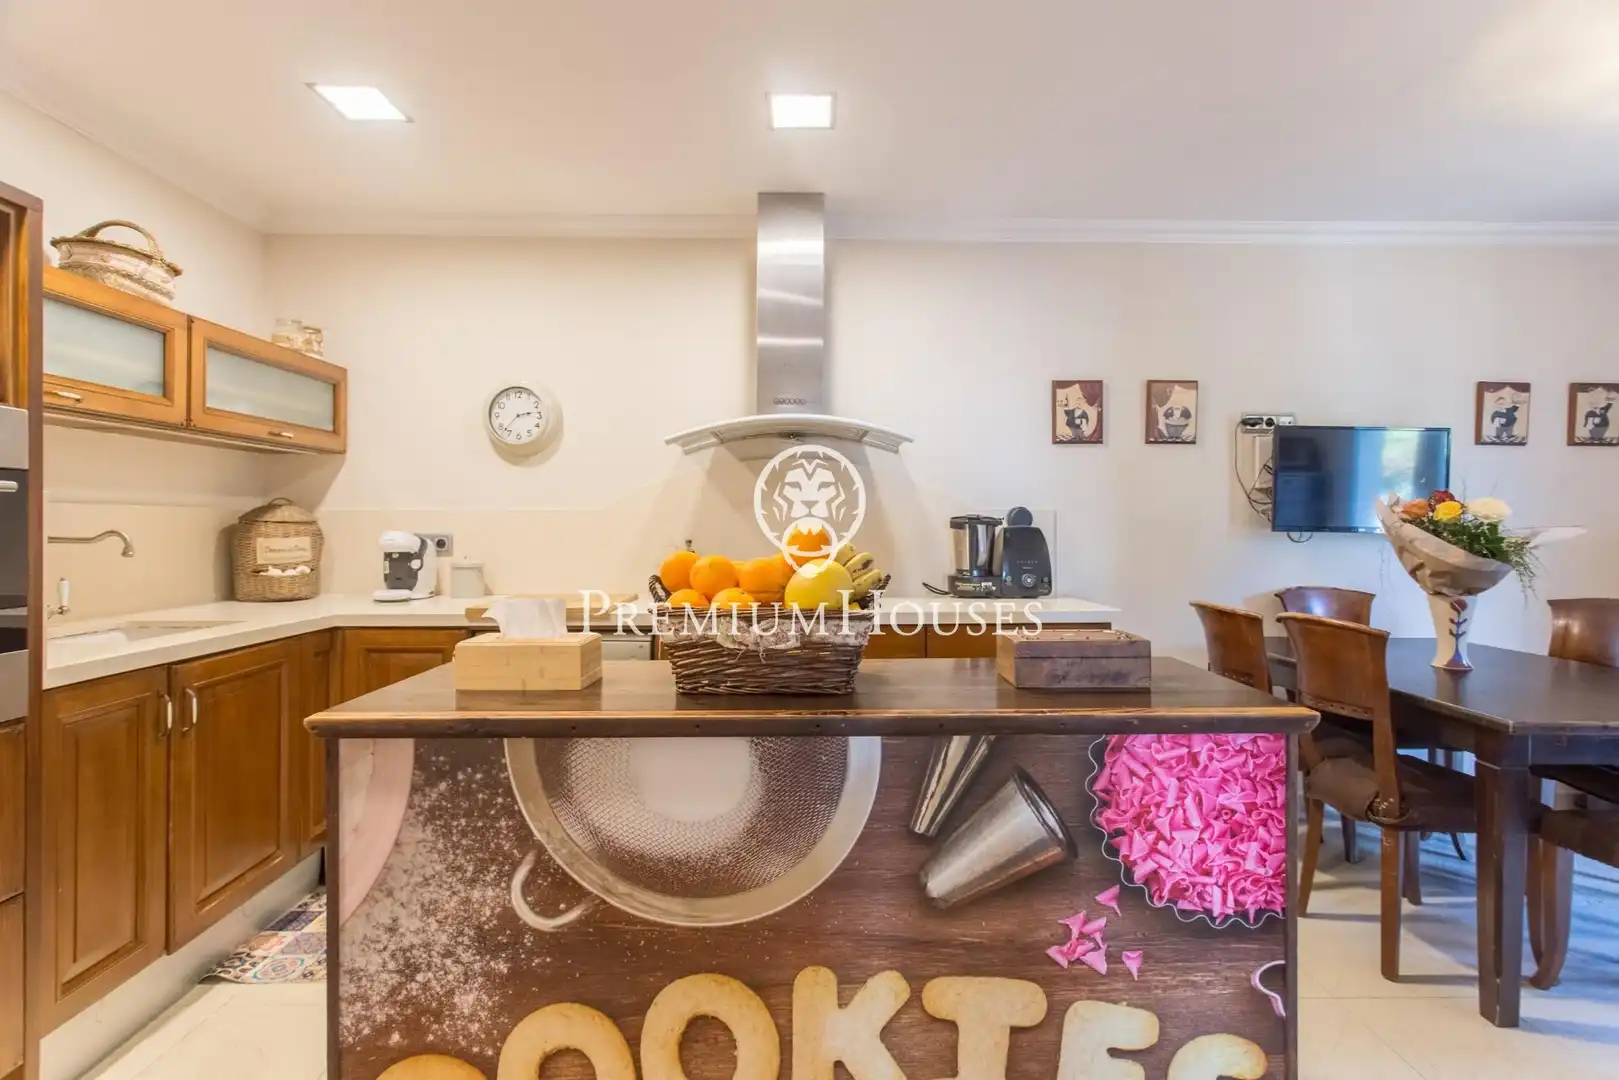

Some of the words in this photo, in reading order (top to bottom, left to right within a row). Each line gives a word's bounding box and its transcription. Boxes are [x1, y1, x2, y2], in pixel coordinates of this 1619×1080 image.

[514, 391, 523, 399] 12
[497, 401, 506, 410] 10
[533, 401, 540, 409] 2
[494, 412, 500, 420] 9
[537, 411, 543, 420] 3
[507, 429, 513, 437] 7
[516, 433, 522, 441] 6
[526, 429, 533, 438] 5
